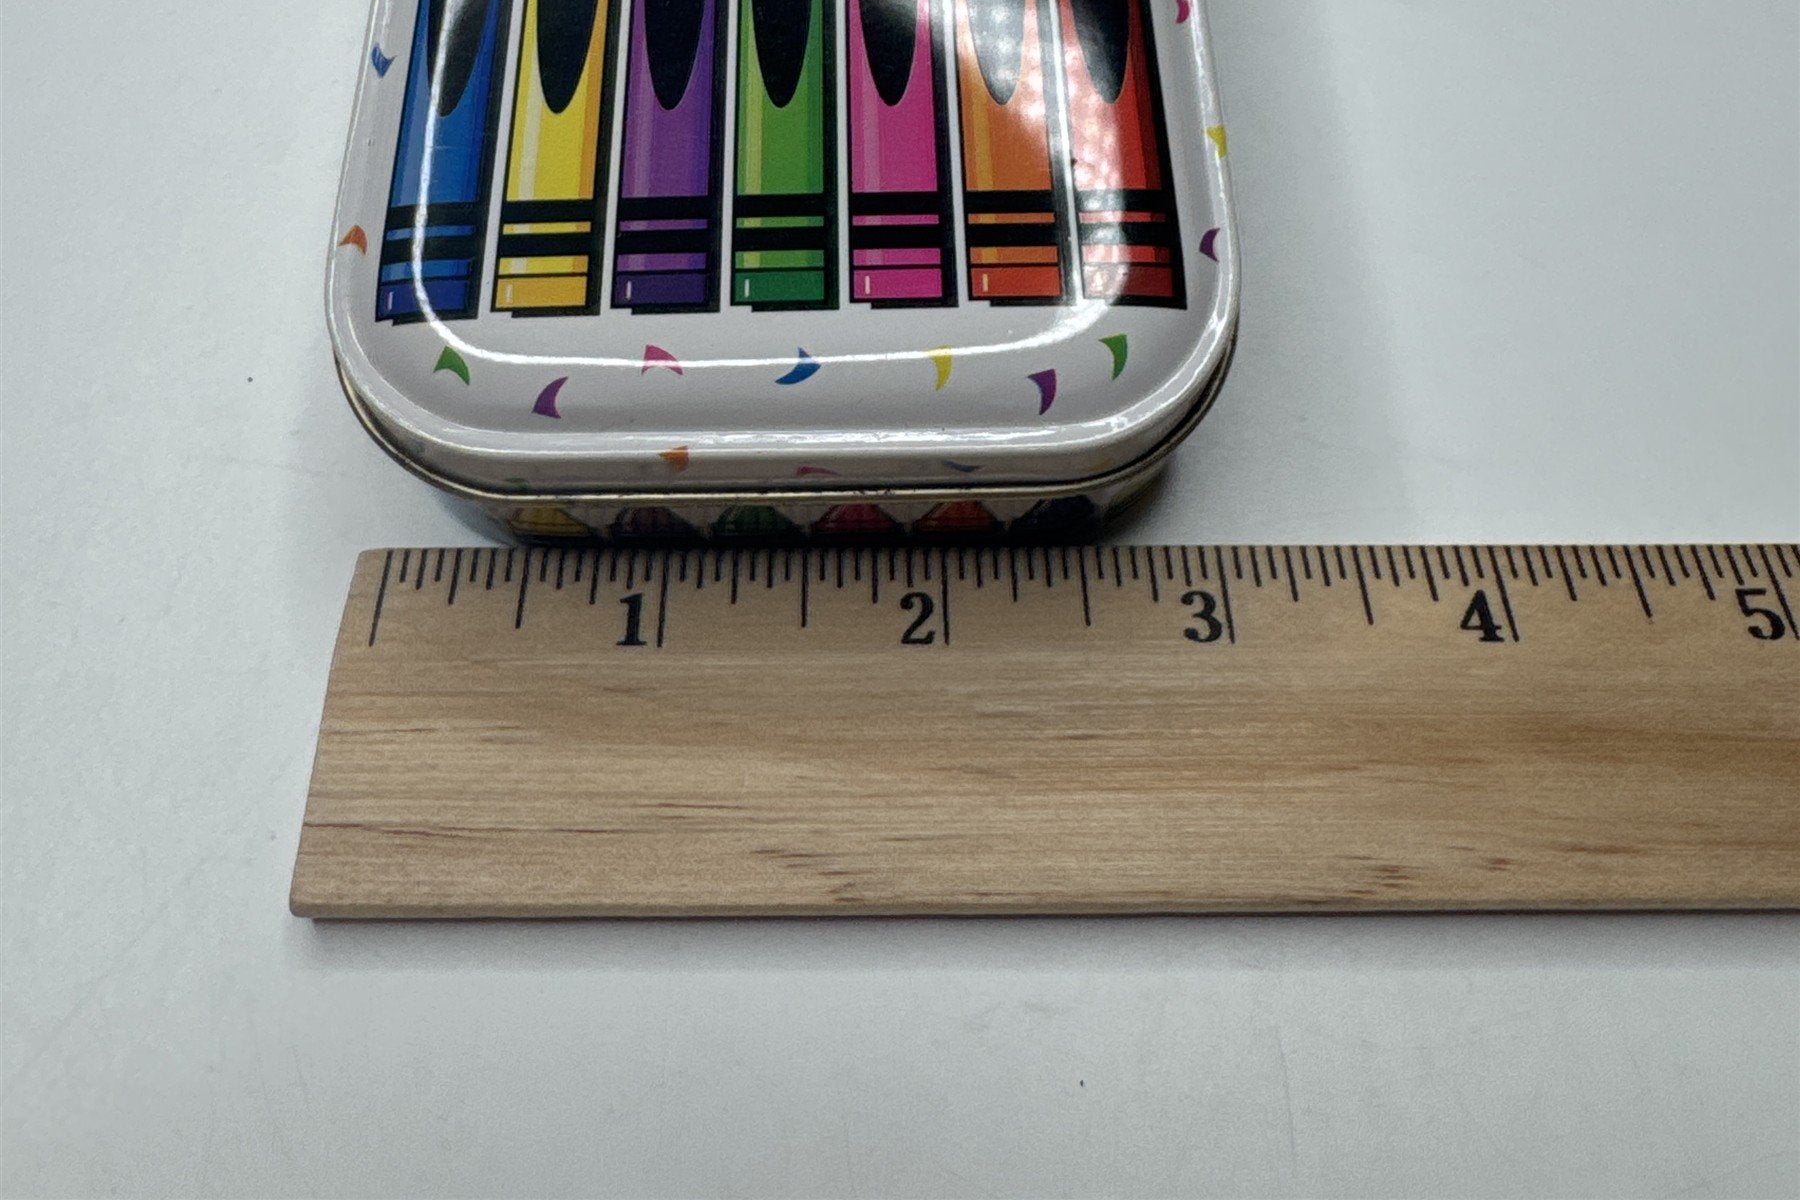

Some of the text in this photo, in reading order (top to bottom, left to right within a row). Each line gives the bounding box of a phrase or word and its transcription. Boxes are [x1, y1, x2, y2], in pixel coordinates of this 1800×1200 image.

[616, 588, 1785, 646] 1 2 3 4 5
